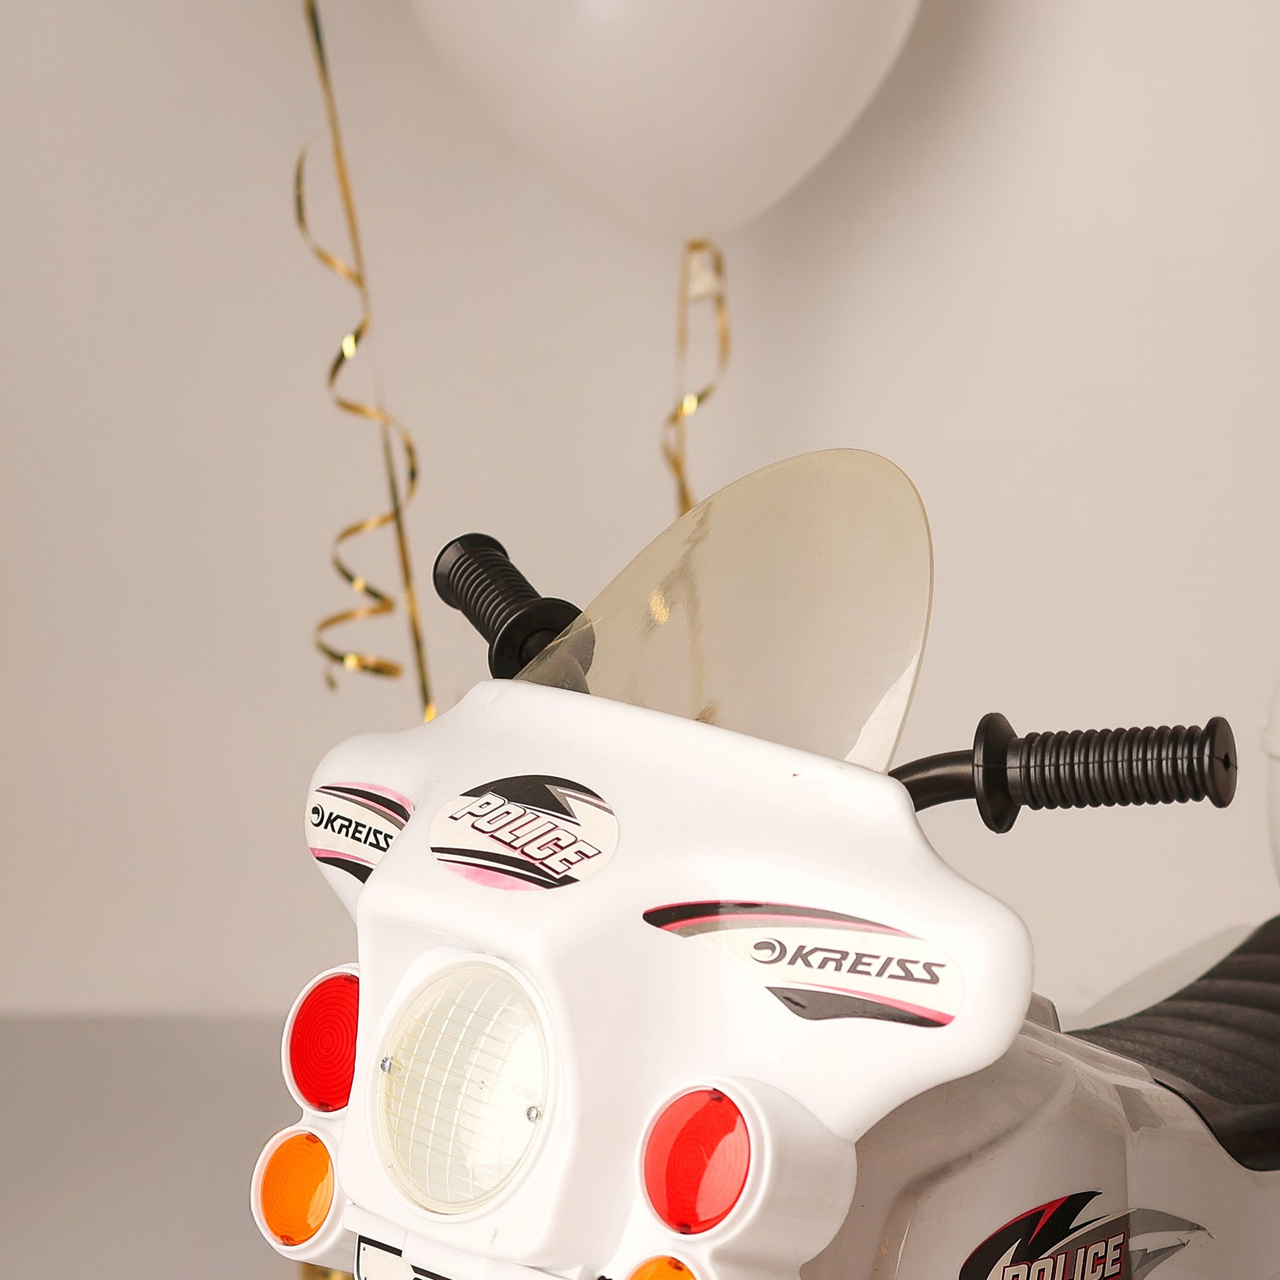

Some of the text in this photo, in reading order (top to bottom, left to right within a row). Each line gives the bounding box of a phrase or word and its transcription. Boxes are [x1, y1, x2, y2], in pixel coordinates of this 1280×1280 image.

[323, 810, 394, 852] KREISS
[447, 792, 603, 878] POLICE
[788, 945, 948, 985] KREISS
